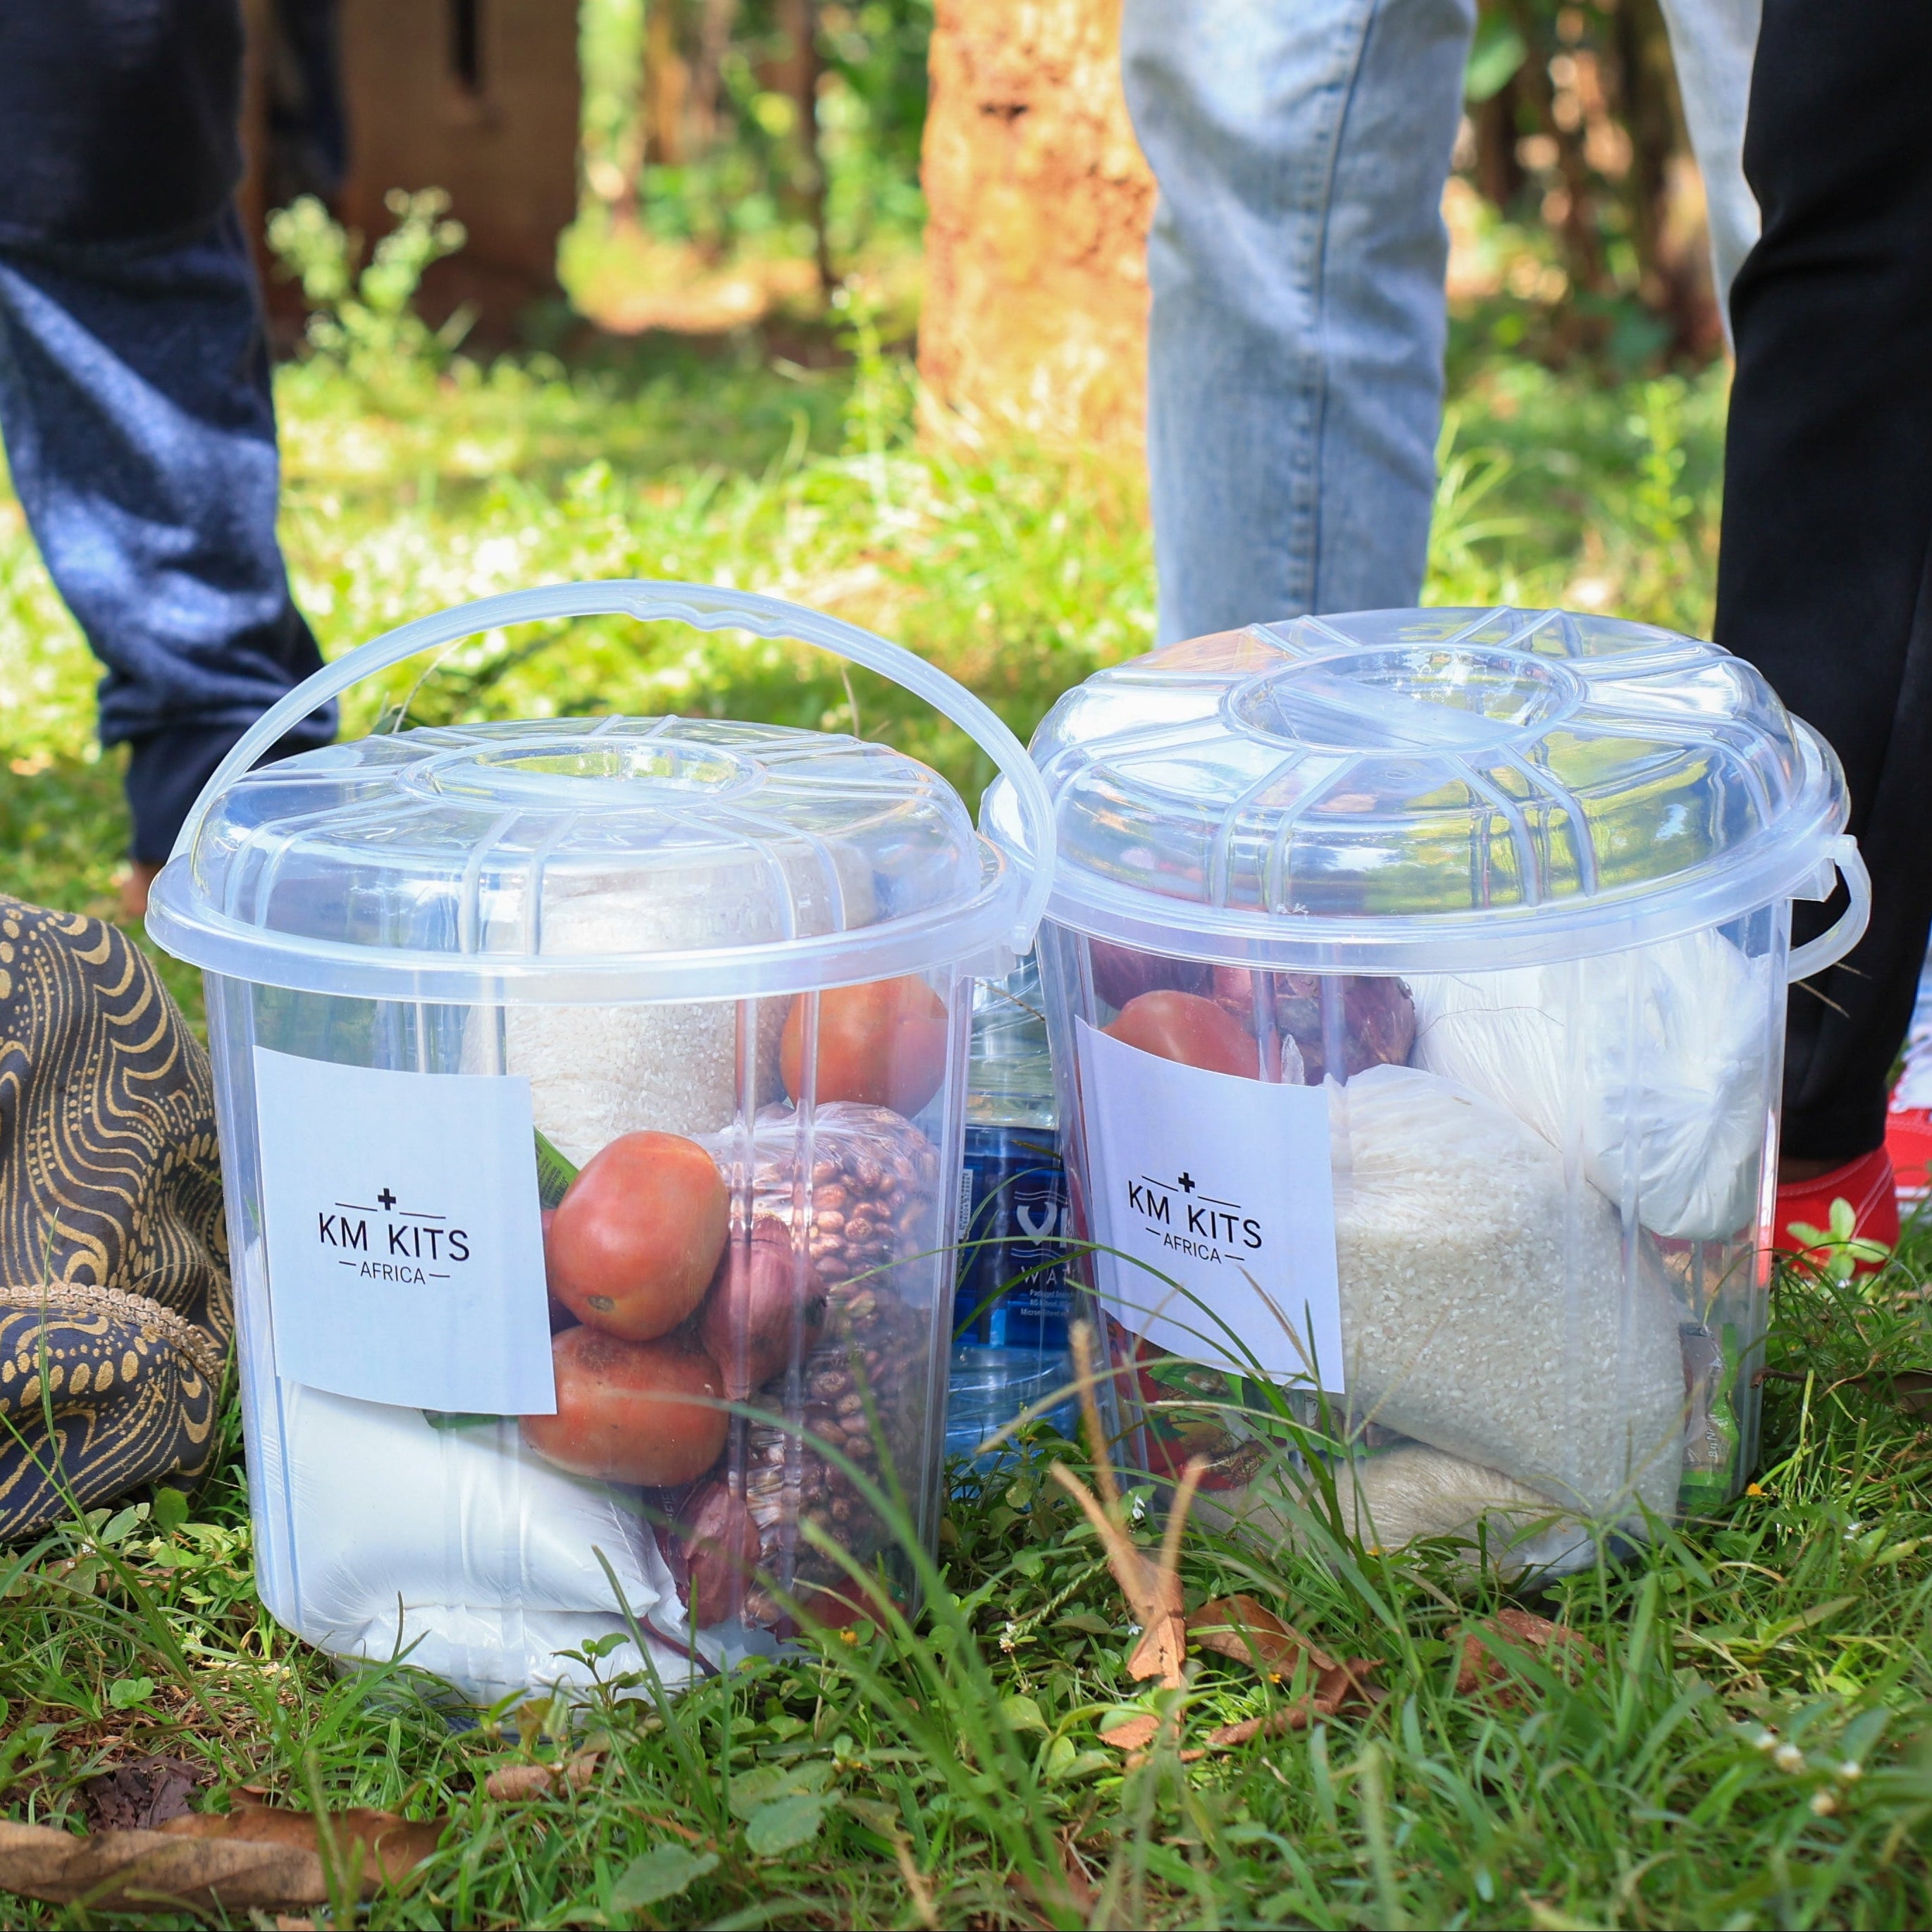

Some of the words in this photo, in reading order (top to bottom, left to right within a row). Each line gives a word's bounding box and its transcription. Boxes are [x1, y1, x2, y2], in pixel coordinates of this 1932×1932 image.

[1128, 1179, 1170, 1226] KM
[1187, 1204, 1262, 1250] KITS
[318, 1212, 368, 1251] KM
[388, 1224, 470, 1262] KITS
[1163, 1232, 1222, 1264] AFRICA
[359, 1261, 426, 1285] AFRICA
